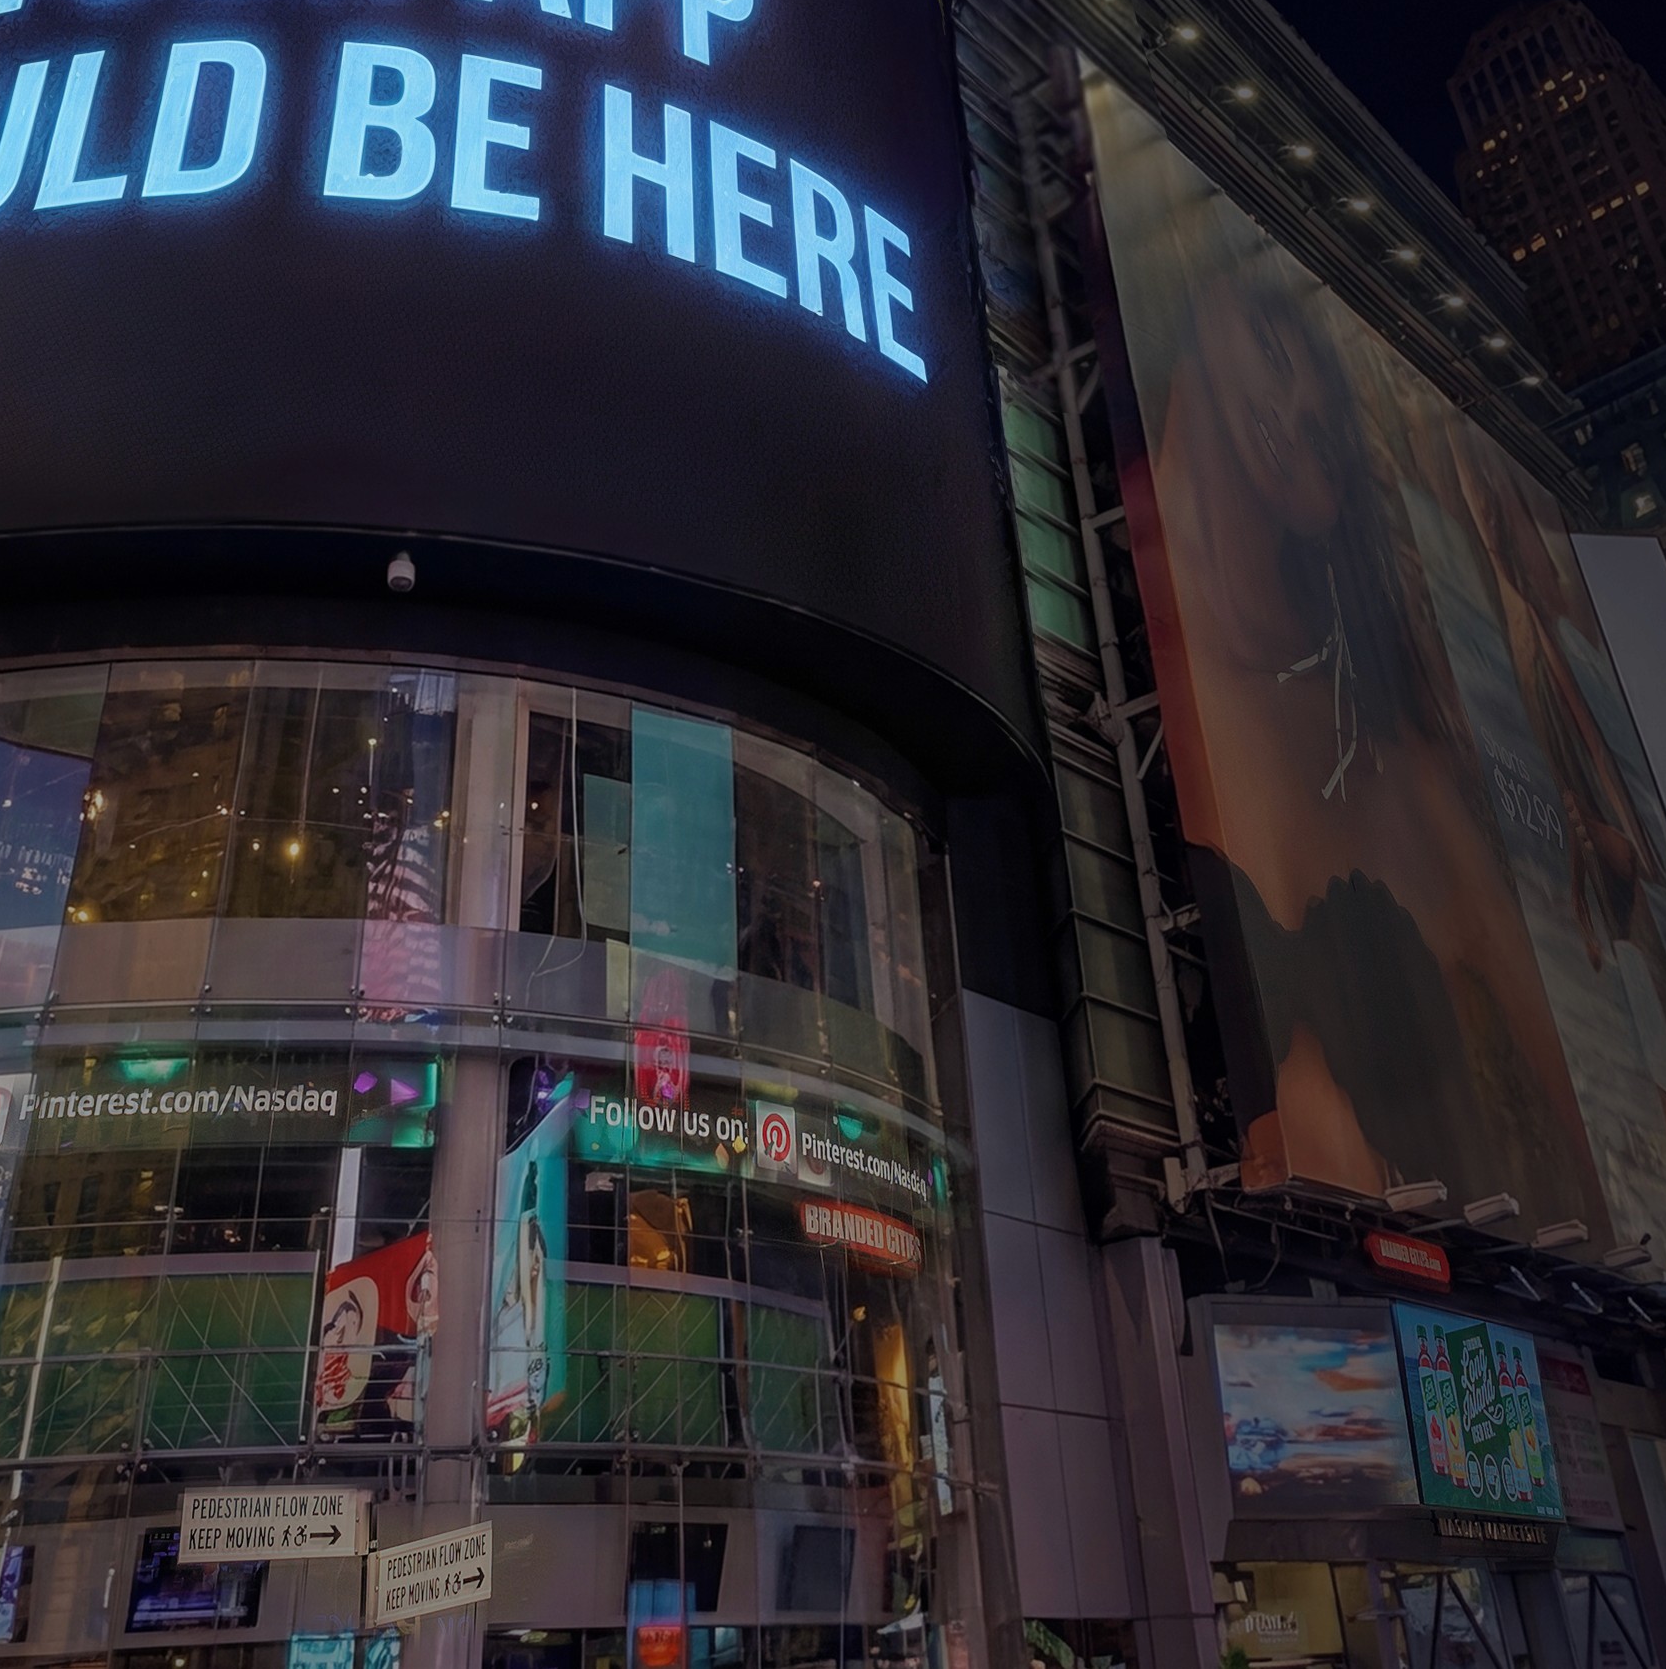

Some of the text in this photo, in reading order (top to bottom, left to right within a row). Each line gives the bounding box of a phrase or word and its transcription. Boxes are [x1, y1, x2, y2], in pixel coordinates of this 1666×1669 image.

[323, 41, 543, 221] BE
[602, 84, 928, 384] HERE
[1493, 764, 1564, 849] $12.99
[19, 1084, 338, 1121] Pinterest.com/Nasdaq
[590, 1095, 749, 1144] Follow us on:
[801, 1132, 928, 1201] Pinterest.com/Nasdaq
[805, 1204, 883, 1249] BRANDED
[192, 1495, 344, 1519] PEDESTRIAN FLOW ZONE
[189, 1526, 275, 1550] KEEP MOVING
[387, 1534, 487, 1581] PEDESTRIAN FLOW ZONE
[386, 1578, 440, 1611] KEEP MOVING
